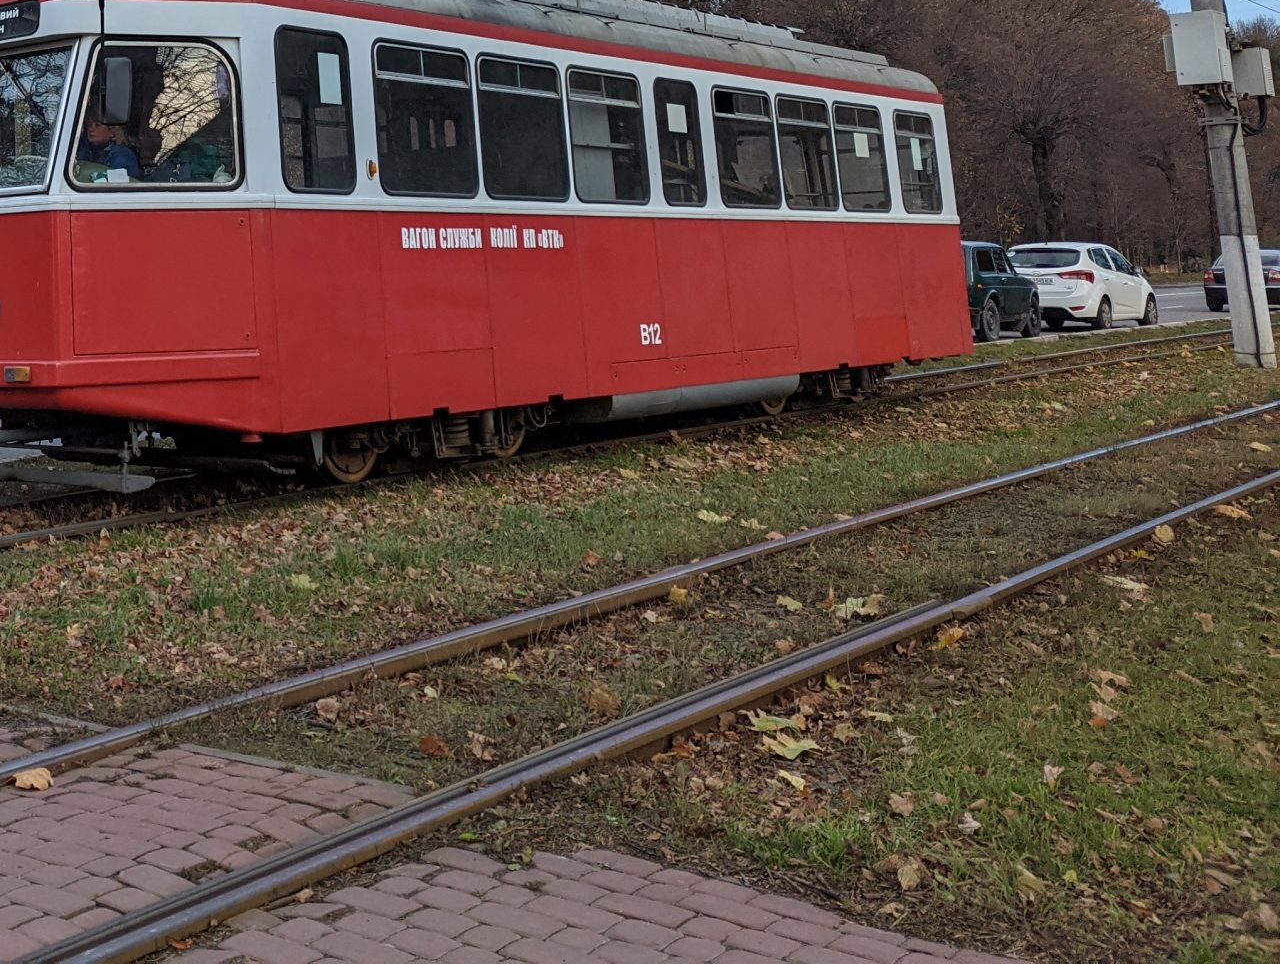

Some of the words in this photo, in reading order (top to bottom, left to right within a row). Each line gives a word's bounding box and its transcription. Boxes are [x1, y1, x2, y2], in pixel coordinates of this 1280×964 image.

[401, 227, 436, 249] ВАГОН
[439, 227, 483, 249] СЛУЖБИ
[490, 224, 518, 248] КОЛІЇ
[522, 228, 536, 249] КП
